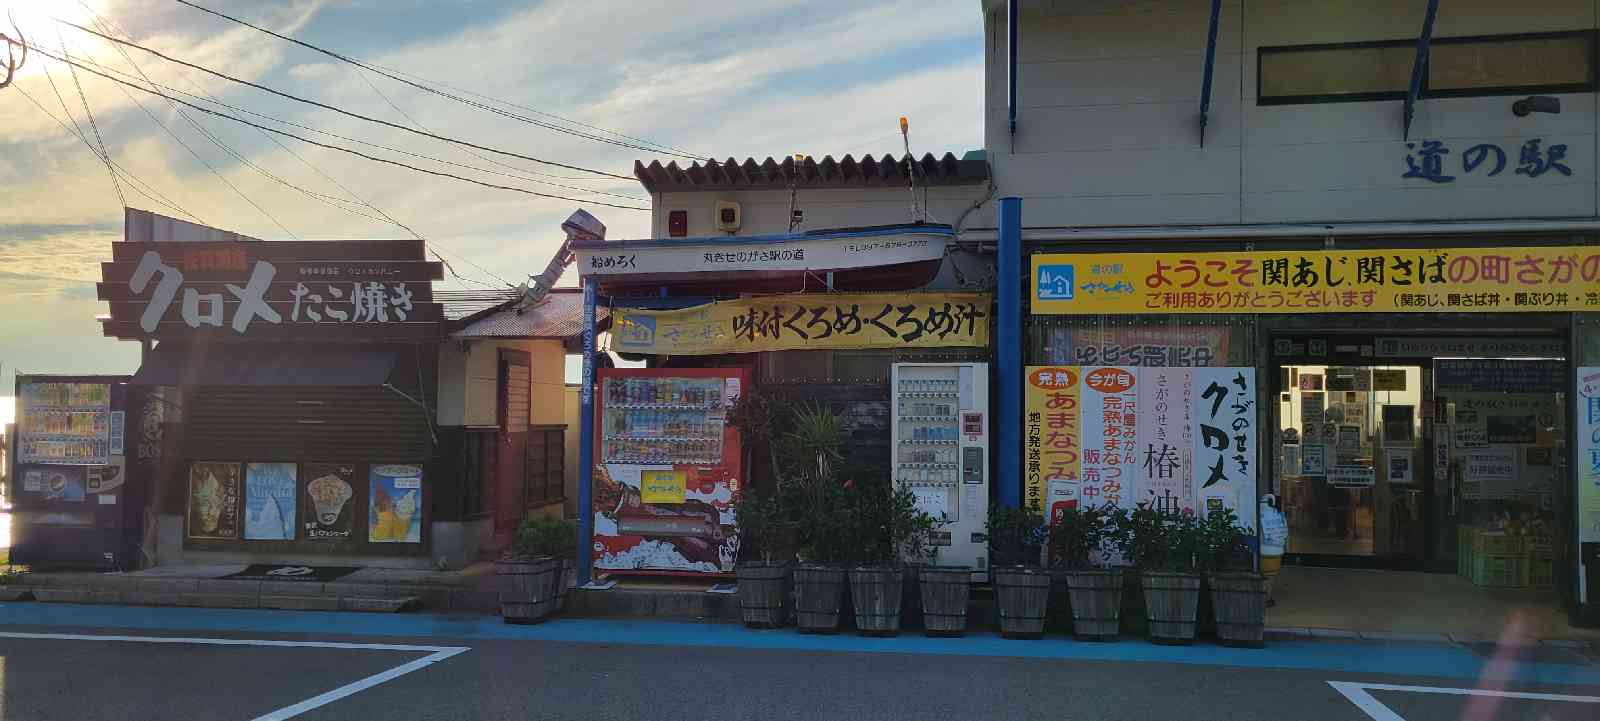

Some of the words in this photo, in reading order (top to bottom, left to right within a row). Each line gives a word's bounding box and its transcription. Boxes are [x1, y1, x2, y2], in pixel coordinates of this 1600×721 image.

[1402, 139, 1572, 183] 道の駅
[129, 250, 282, 333] クロメ
[289, 281, 413, 323] たこ焼き
[1145, 290, 1377, 309] ご利用ありがとうございます
[732, 302, 986, 343] 味付くろめ・くろめ汁
[1090, 373, 1130, 387] 今が旬
[1155, 374, 1168, 441] さがのせき
[1044, 393, 1078, 481] あまなつみ
[1201, 381, 1230, 489] クロメ
[1084, 449, 1100, 500] 販売中
[1143, 443, 1180, 519] 椿油
